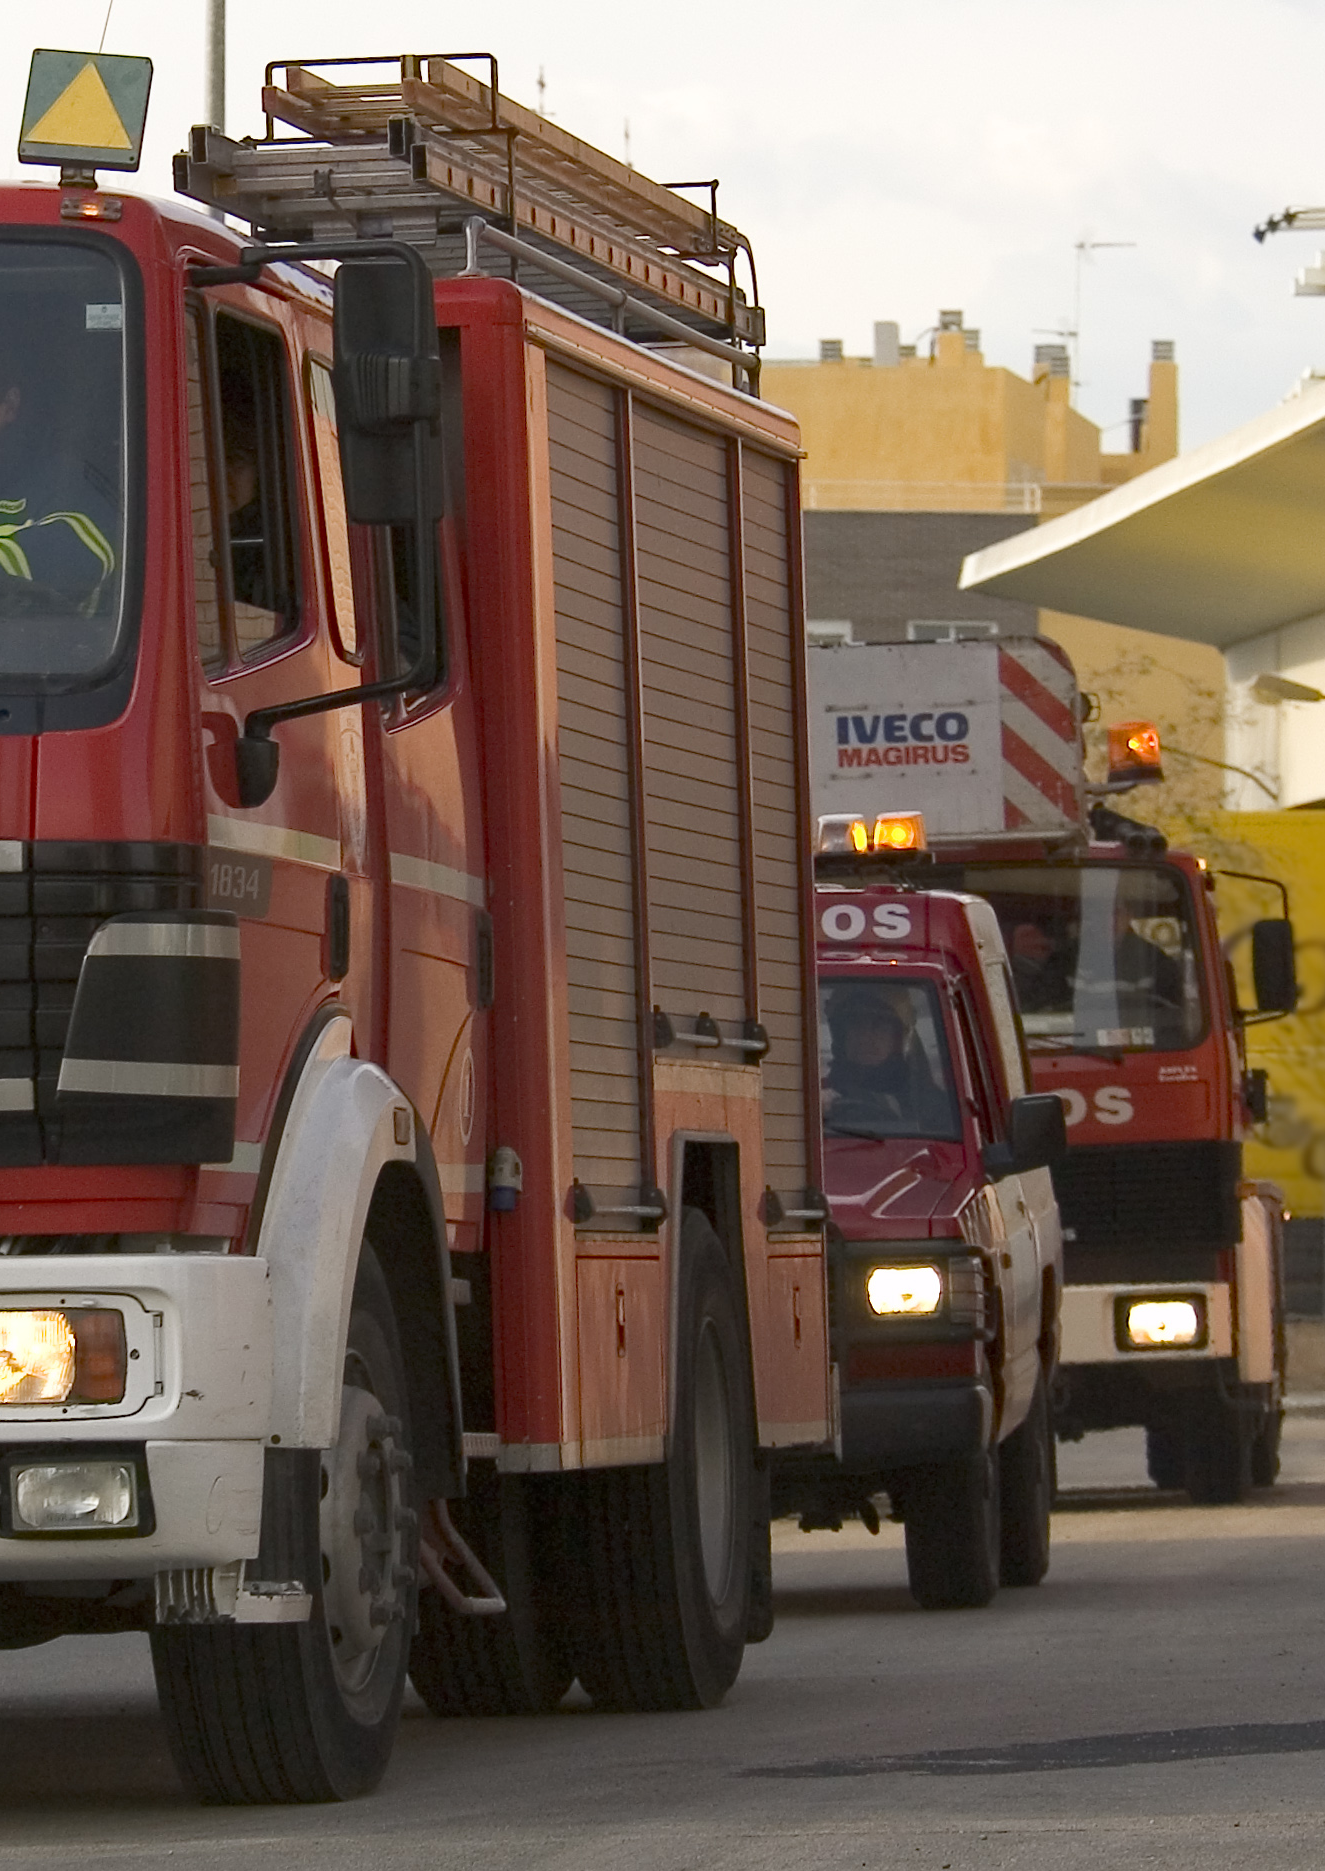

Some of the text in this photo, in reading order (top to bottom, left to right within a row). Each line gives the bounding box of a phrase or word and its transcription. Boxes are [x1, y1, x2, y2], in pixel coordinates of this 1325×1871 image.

[836, 712, 969, 745] IVECO
[837, 744, 970, 768] MAGIRUS
[210, 863, 260, 900] 1834
[821, 903, 911, 941] OS
